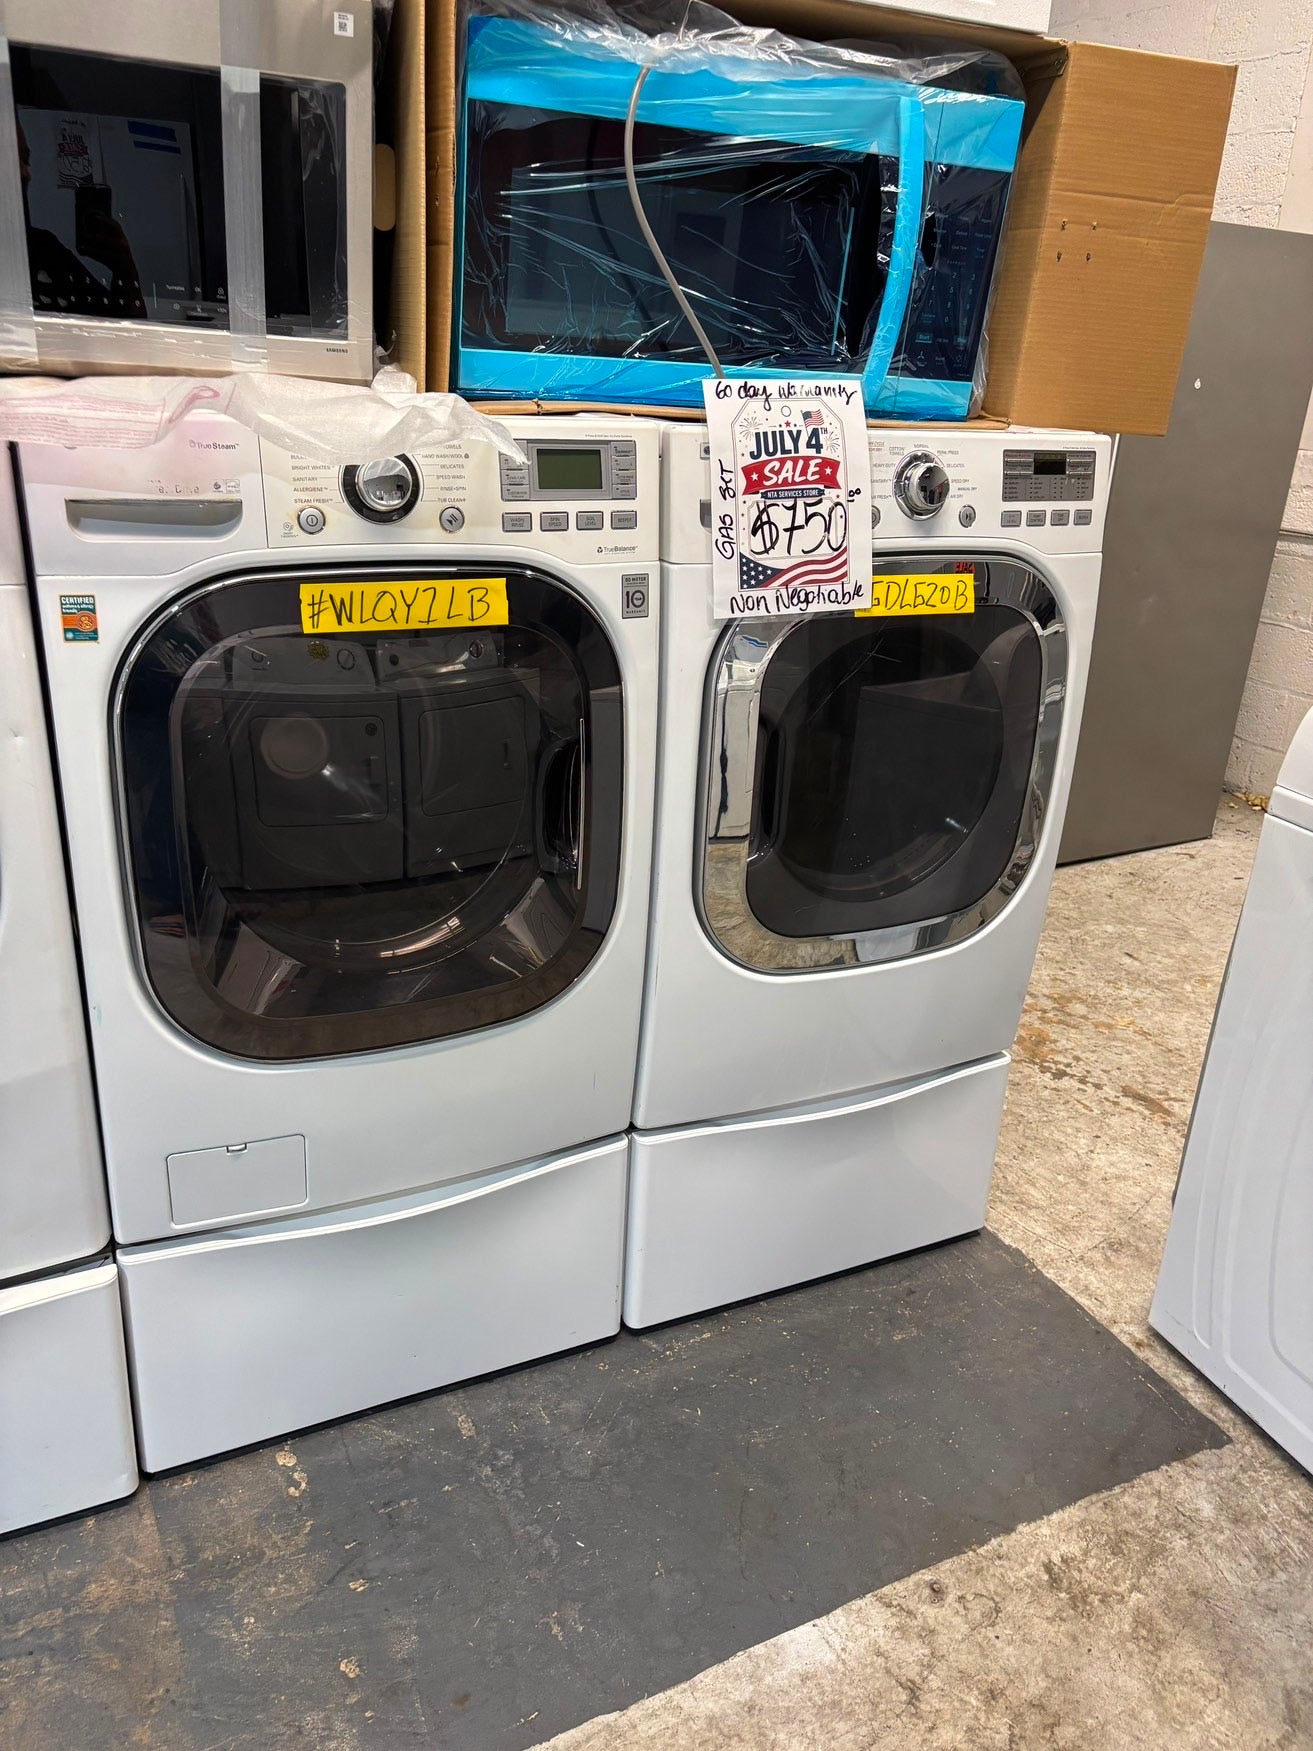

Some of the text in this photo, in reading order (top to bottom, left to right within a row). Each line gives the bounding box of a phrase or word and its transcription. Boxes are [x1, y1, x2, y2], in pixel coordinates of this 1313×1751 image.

[715, 380, 733, 400] 60
[738, 381, 773, 411] day
[749, 429, 802, 460] JULY
[762, 459, 821, 486] SALE
[767, 489, 819, 499] NTA SERVICES STORE
[714, 514, 736, 560] GAS
[750, 497, 848, 556] $750
[61, 596, 94, 604] CERTIFIED
[625, 589, 646, 609] 10
[730, 580, 865, 616] Non Negotiable
